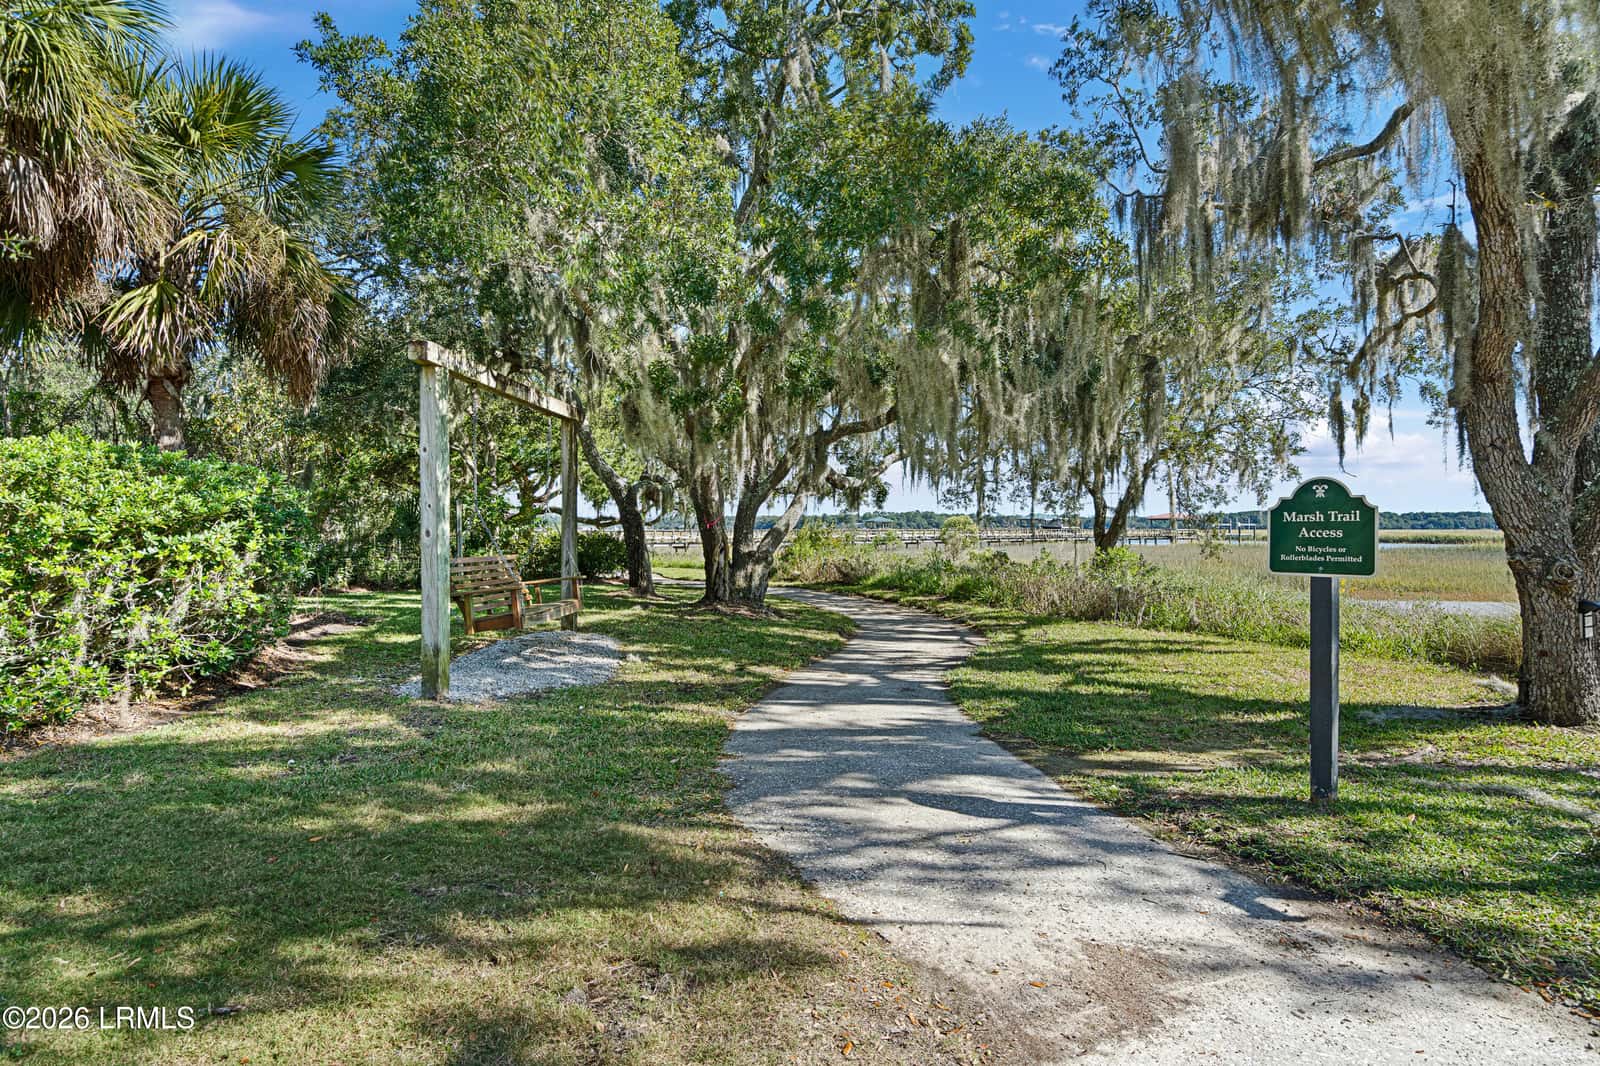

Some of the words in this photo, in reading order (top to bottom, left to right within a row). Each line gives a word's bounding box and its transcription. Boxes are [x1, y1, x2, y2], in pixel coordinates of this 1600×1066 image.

[1283, 511, 1325, 522] Marsh
[1328, 510, 1360, 521] Trail
[1298, 527, 1344, 538] Access
[1307, 546, 1337, 554] Bicycles
